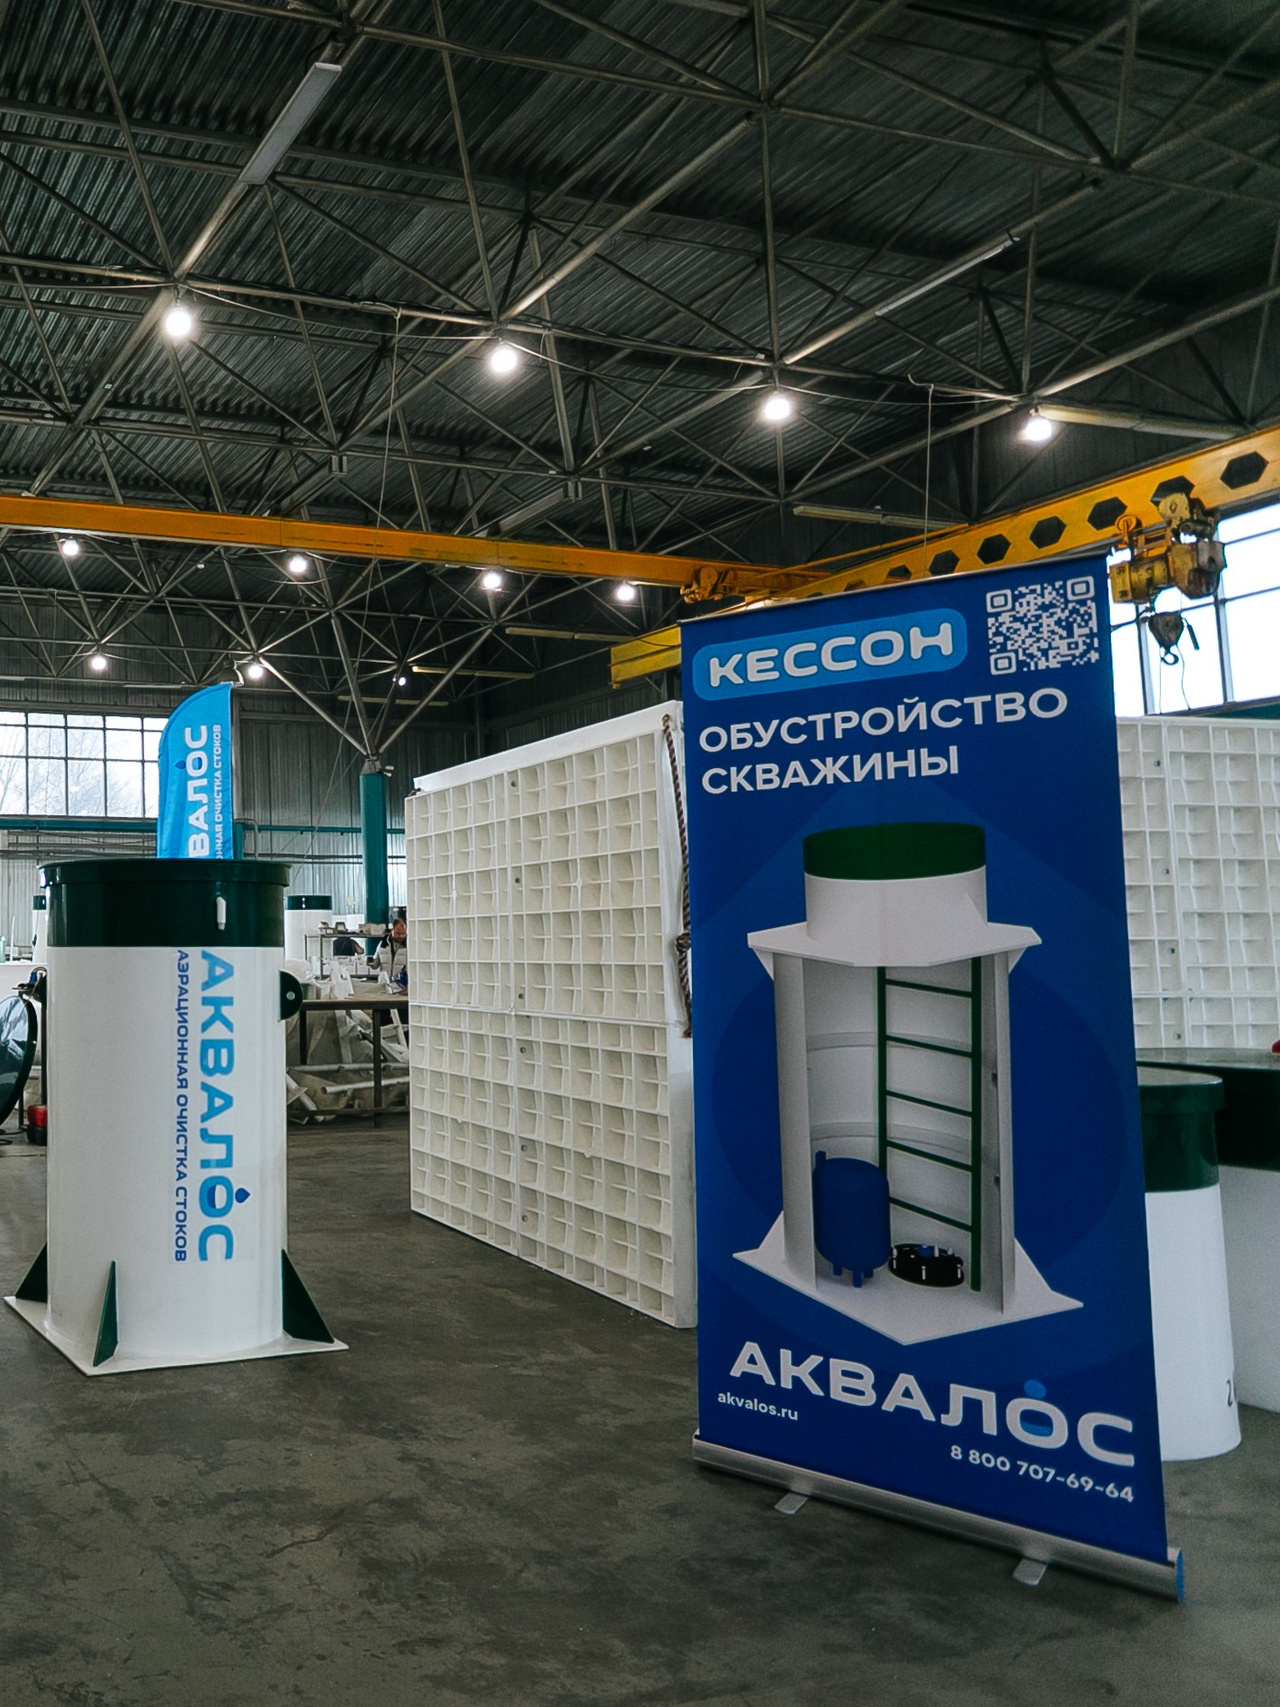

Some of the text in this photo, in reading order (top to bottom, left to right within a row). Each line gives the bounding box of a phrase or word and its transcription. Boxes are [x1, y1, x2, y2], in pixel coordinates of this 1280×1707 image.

[709, 622, 953, 687] КЕССОН
[212, 724, 222, 769] СТОКОВ
[699, 687, 1068, 753] ОБУСТРОЙСТВО
[213, 770, 223, 821] ОЧИСТКА
[701, 745, 959, 794] СКВАЖИНЫ
[174, 949, 189, 1262] АЭРАЦИОННАЯ ОЧИСТКА СТОКОВ
[198, 949, 234, 1261] АКВАЛОС
[718, 1391, 799, 1421] akvalos.ru
[730, 1341, 1135, 1467] АКВАЛОС
[950, 1445, 1134, 1503] 8 800 707-69-64
